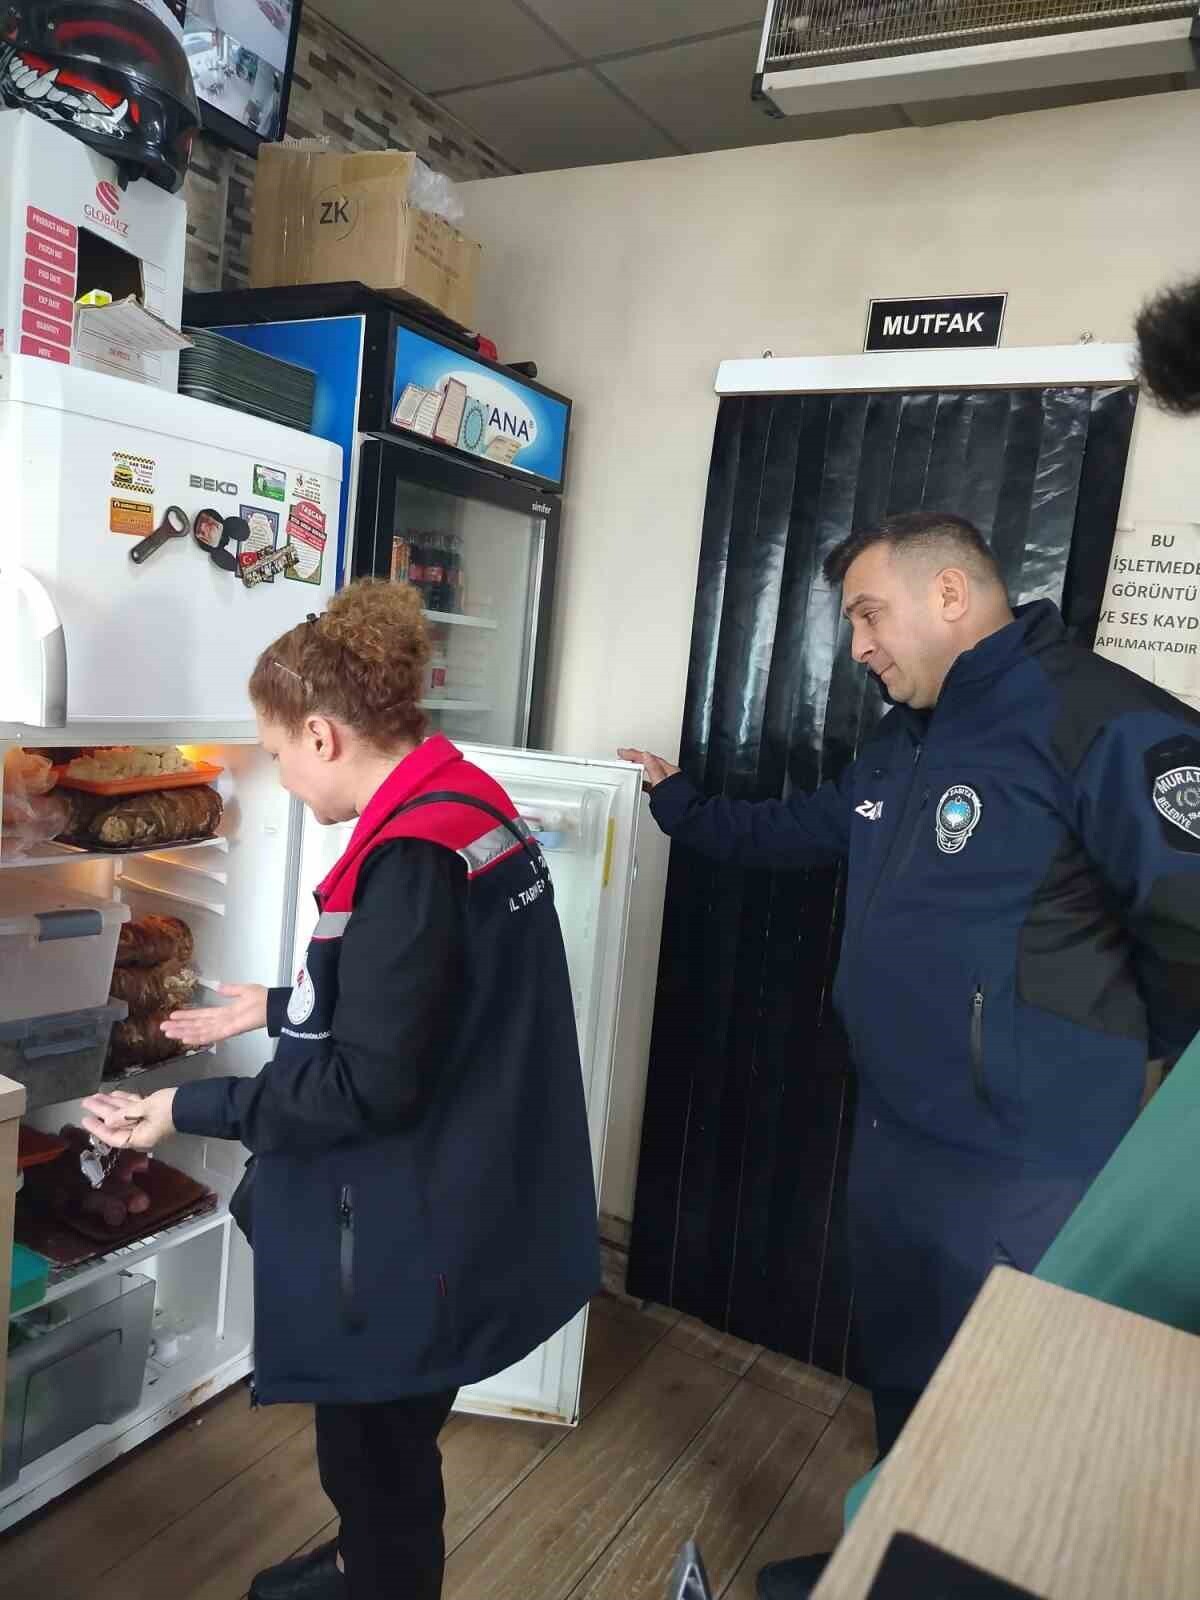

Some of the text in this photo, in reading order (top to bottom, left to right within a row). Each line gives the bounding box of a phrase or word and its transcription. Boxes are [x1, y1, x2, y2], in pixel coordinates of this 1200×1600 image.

[319, 200, 350, 225] ZK
[882, 311, 985, 336] MUTFAK
[189, 473, 239, 496] BEKO
[1151, 534, 1175, 548] BU
[1112, 582, 1197, 600] GÖRÜNTÜ
[1119, 611, 1148, 626] SES
[1153, 613, 1200, 630] KAYD
[1097, 637, 1196, 653] APILMAKTADIR
